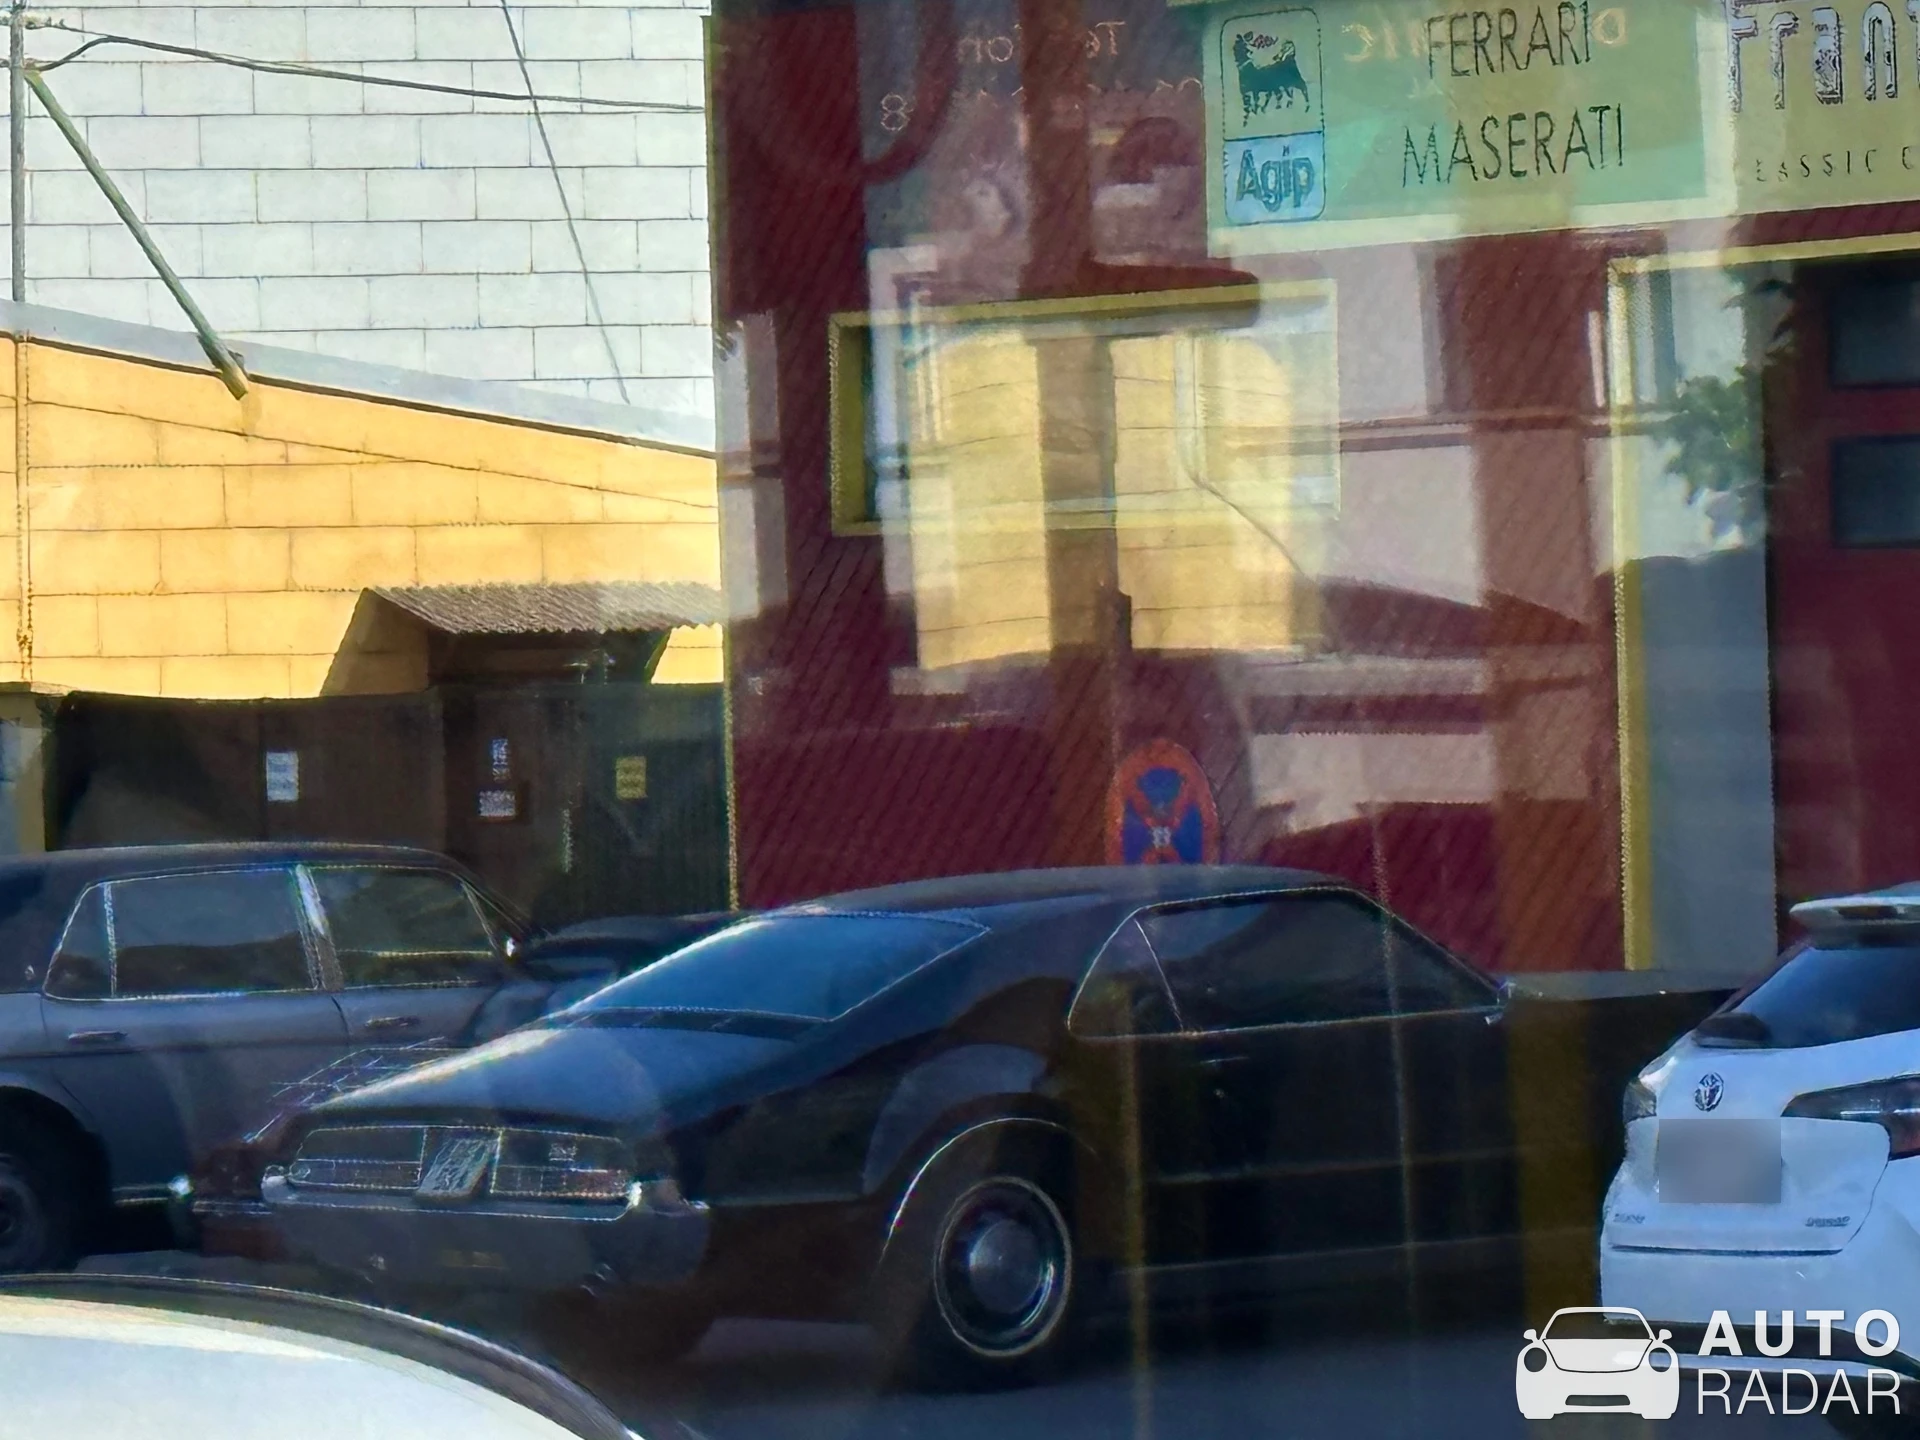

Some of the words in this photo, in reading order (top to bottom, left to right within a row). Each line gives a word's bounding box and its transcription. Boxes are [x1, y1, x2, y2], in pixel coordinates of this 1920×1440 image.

[1427, 1, 1592, 79] FERRARI
[1722, 0, 1920, 114] Fran
[1236, 149, 1315, 212] Agip
[1402, 103, 1623, 188] MASERATI
